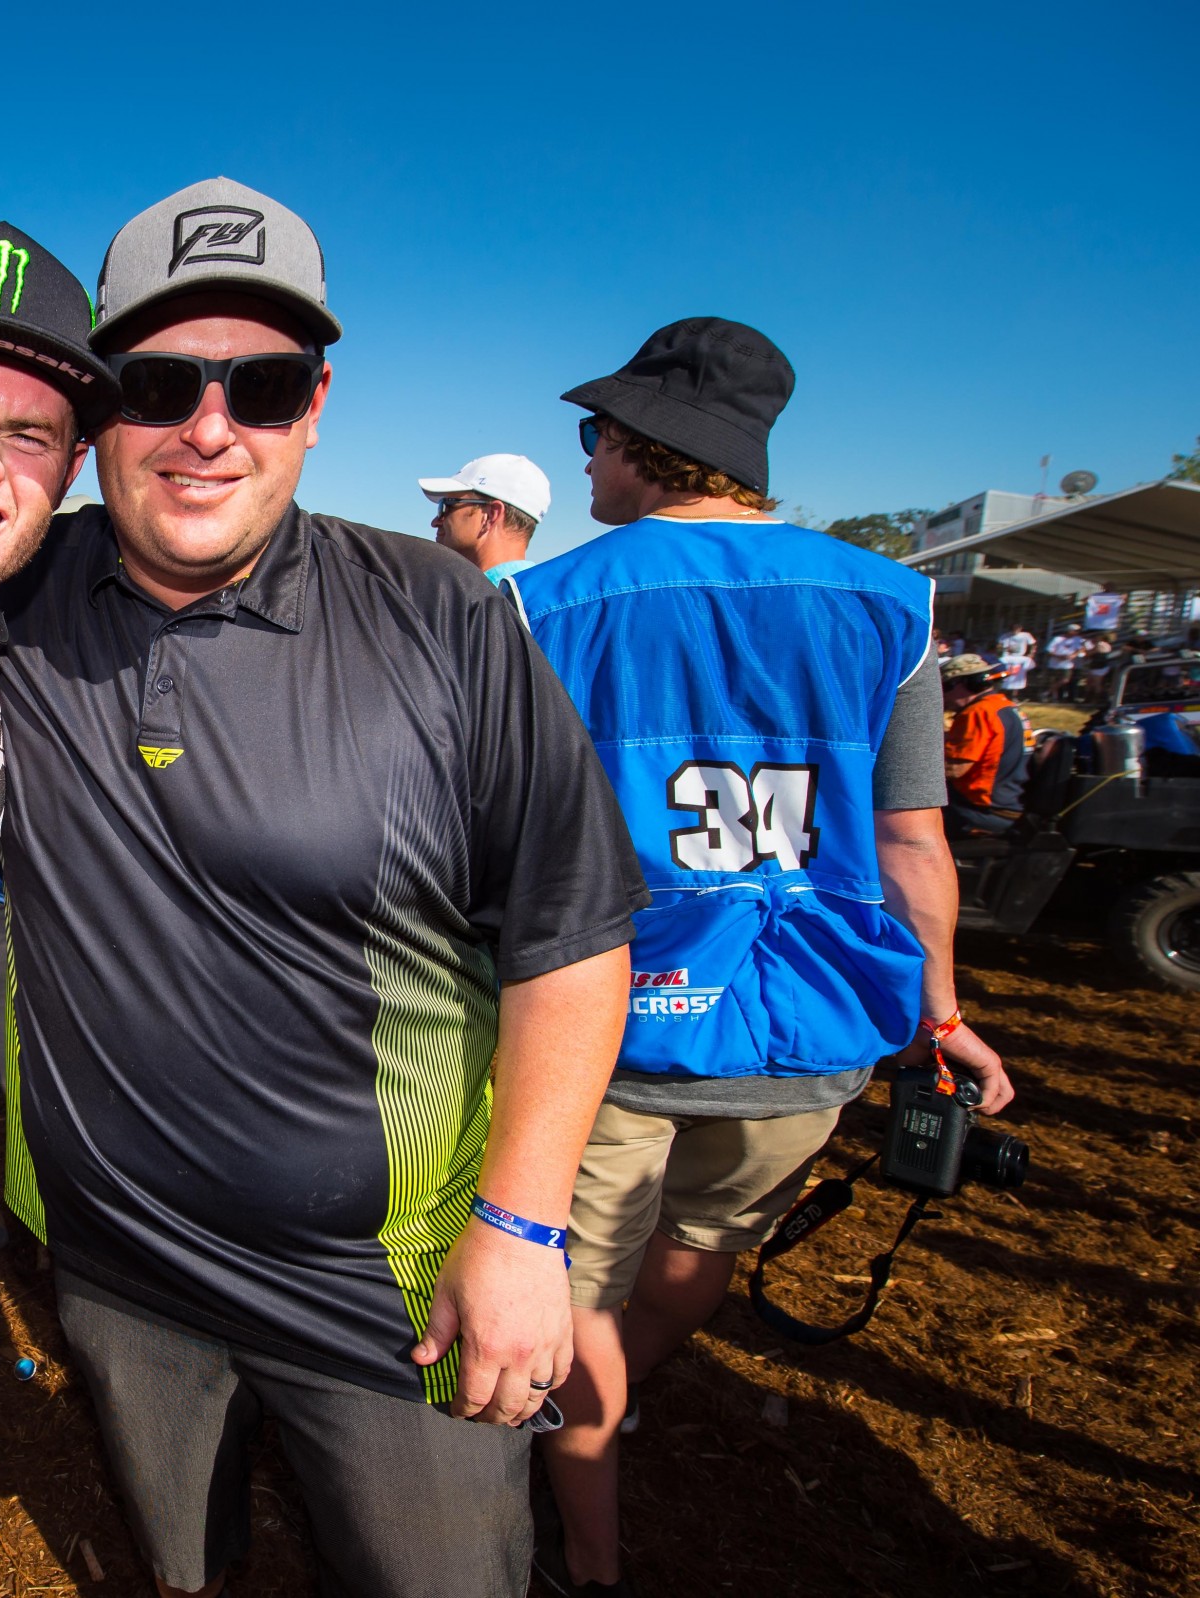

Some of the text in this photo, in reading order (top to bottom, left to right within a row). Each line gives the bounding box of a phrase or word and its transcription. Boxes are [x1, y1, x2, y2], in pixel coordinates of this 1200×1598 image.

[666, 759, 821, 872] 34
[627, 995, 722, 1014] CROS
[474, 1206, 561, 1248] MOTOCROSS 2
[483, 1202, 503, 1217] LUCAS
[785, 1203, 823, 1240] EOS 7D
